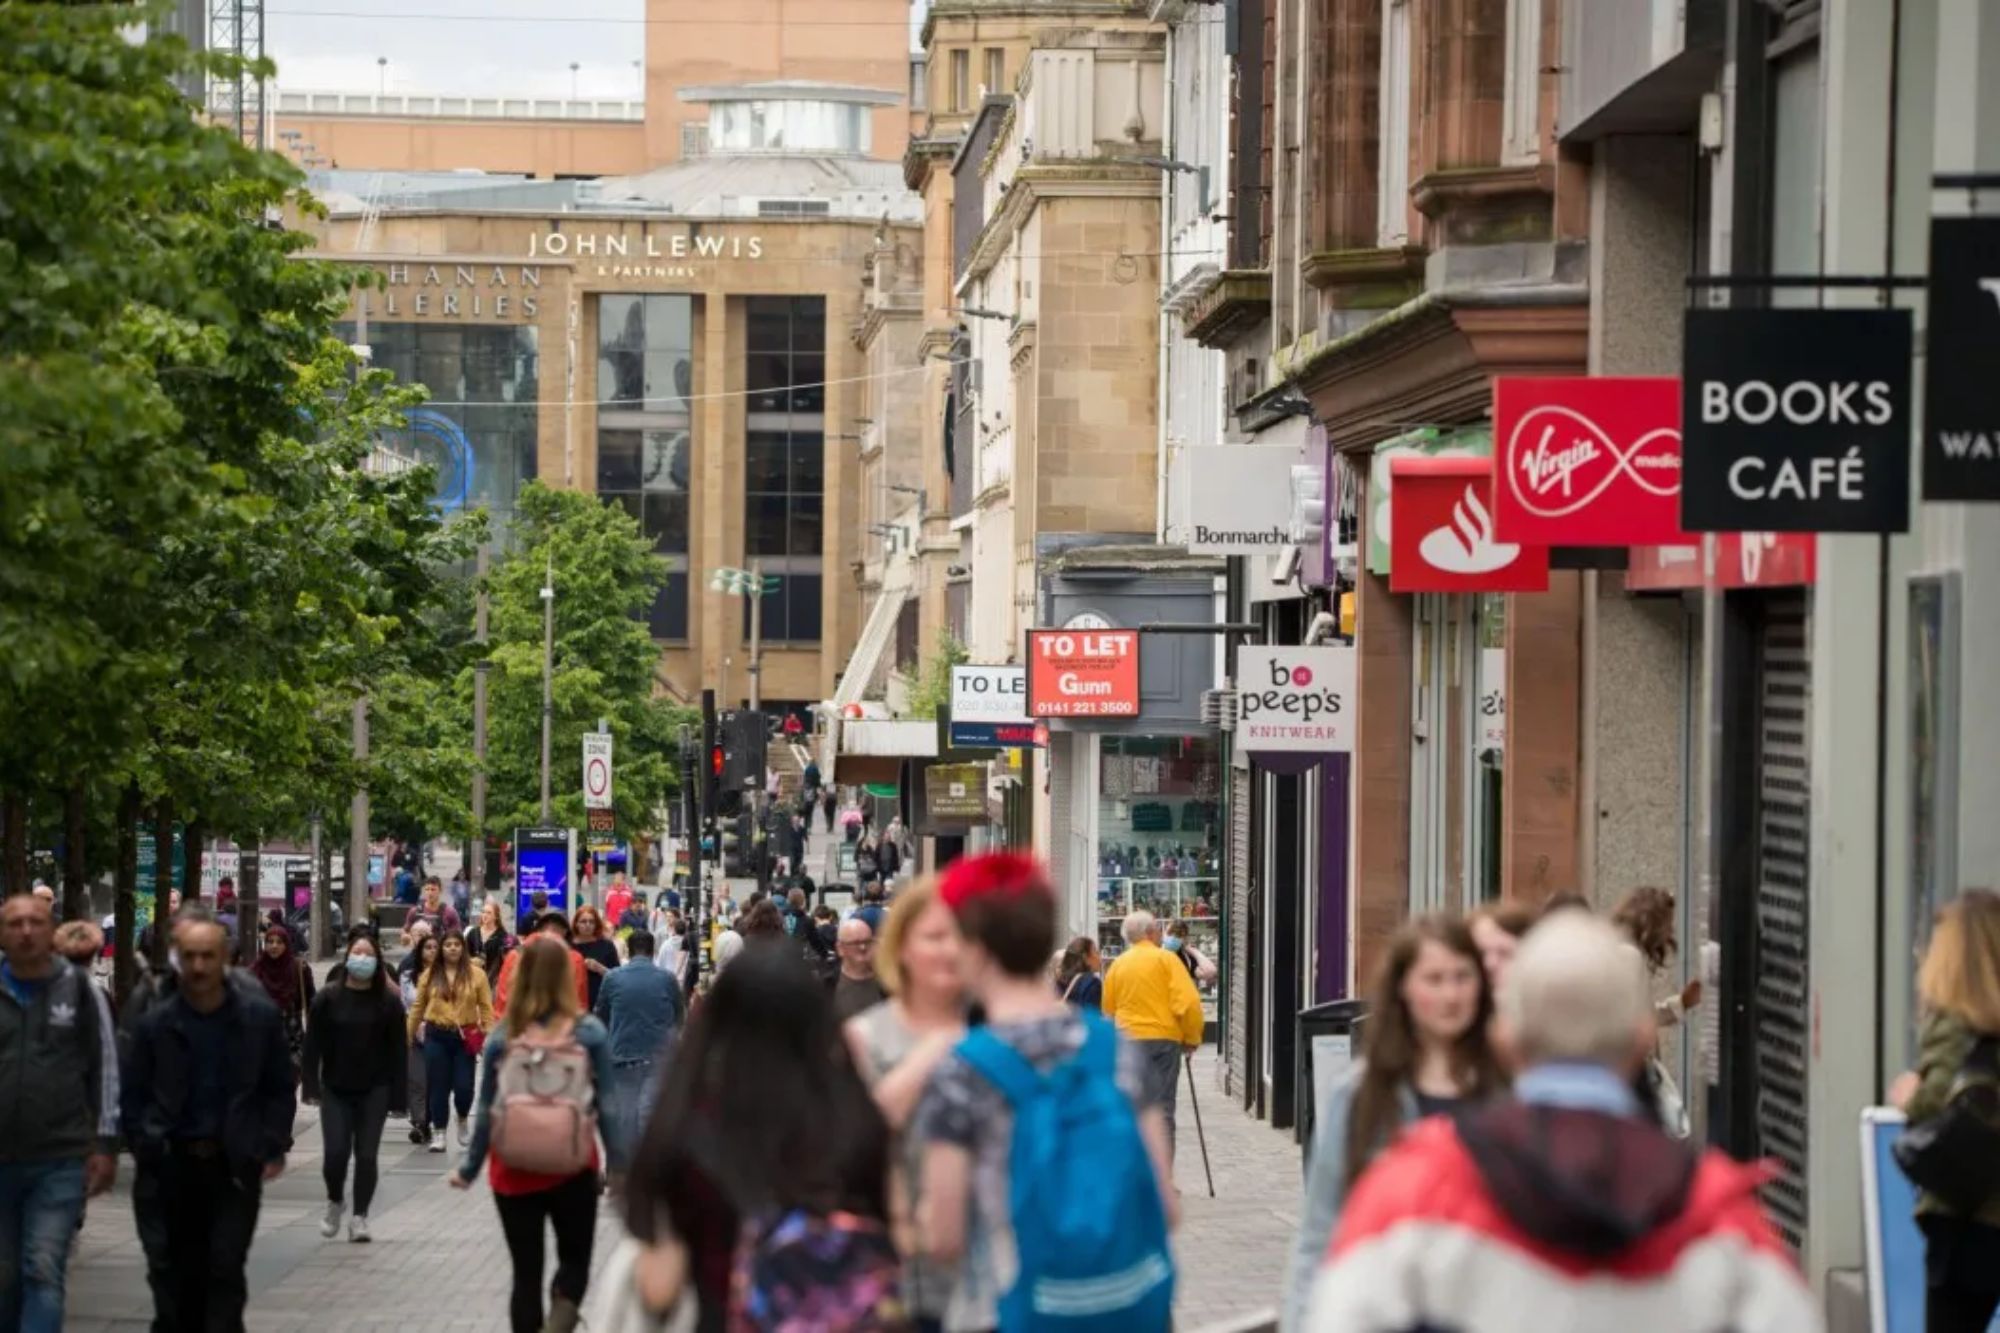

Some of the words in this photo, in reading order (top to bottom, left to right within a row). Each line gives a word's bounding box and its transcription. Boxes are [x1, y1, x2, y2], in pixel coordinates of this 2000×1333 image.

[528, 232, 628, 257] JOHN
[647, 234, 763, 258] LEWIS
[390, 264, 541, 286] HANAN
[613, 265, 697, 278] PARTNERS
[367, 293, 539, 316] LERIES
[1701, 380, 1893, 425] BOOKS
[1520, 424, 1602, 497] Virgin
[1728, 446, 1864, 500] CAFÉ
[1038, 635, 1075, 657] TO
[1083, 635, 1132, 657] LET
[958, 675, 989, 693] TO
[997, 677, 1025, 694] LE
[1058, 672, 1112, 696] Gunn
[1038, 702, 1069, 713] 0141
[1073, 702, 1096, 713] 221
[1100, 702, 1132, 713] 3500
[1240, 686, 1342, 722] peep's
[1248, 725, 1337, 739] KNITWEAR
